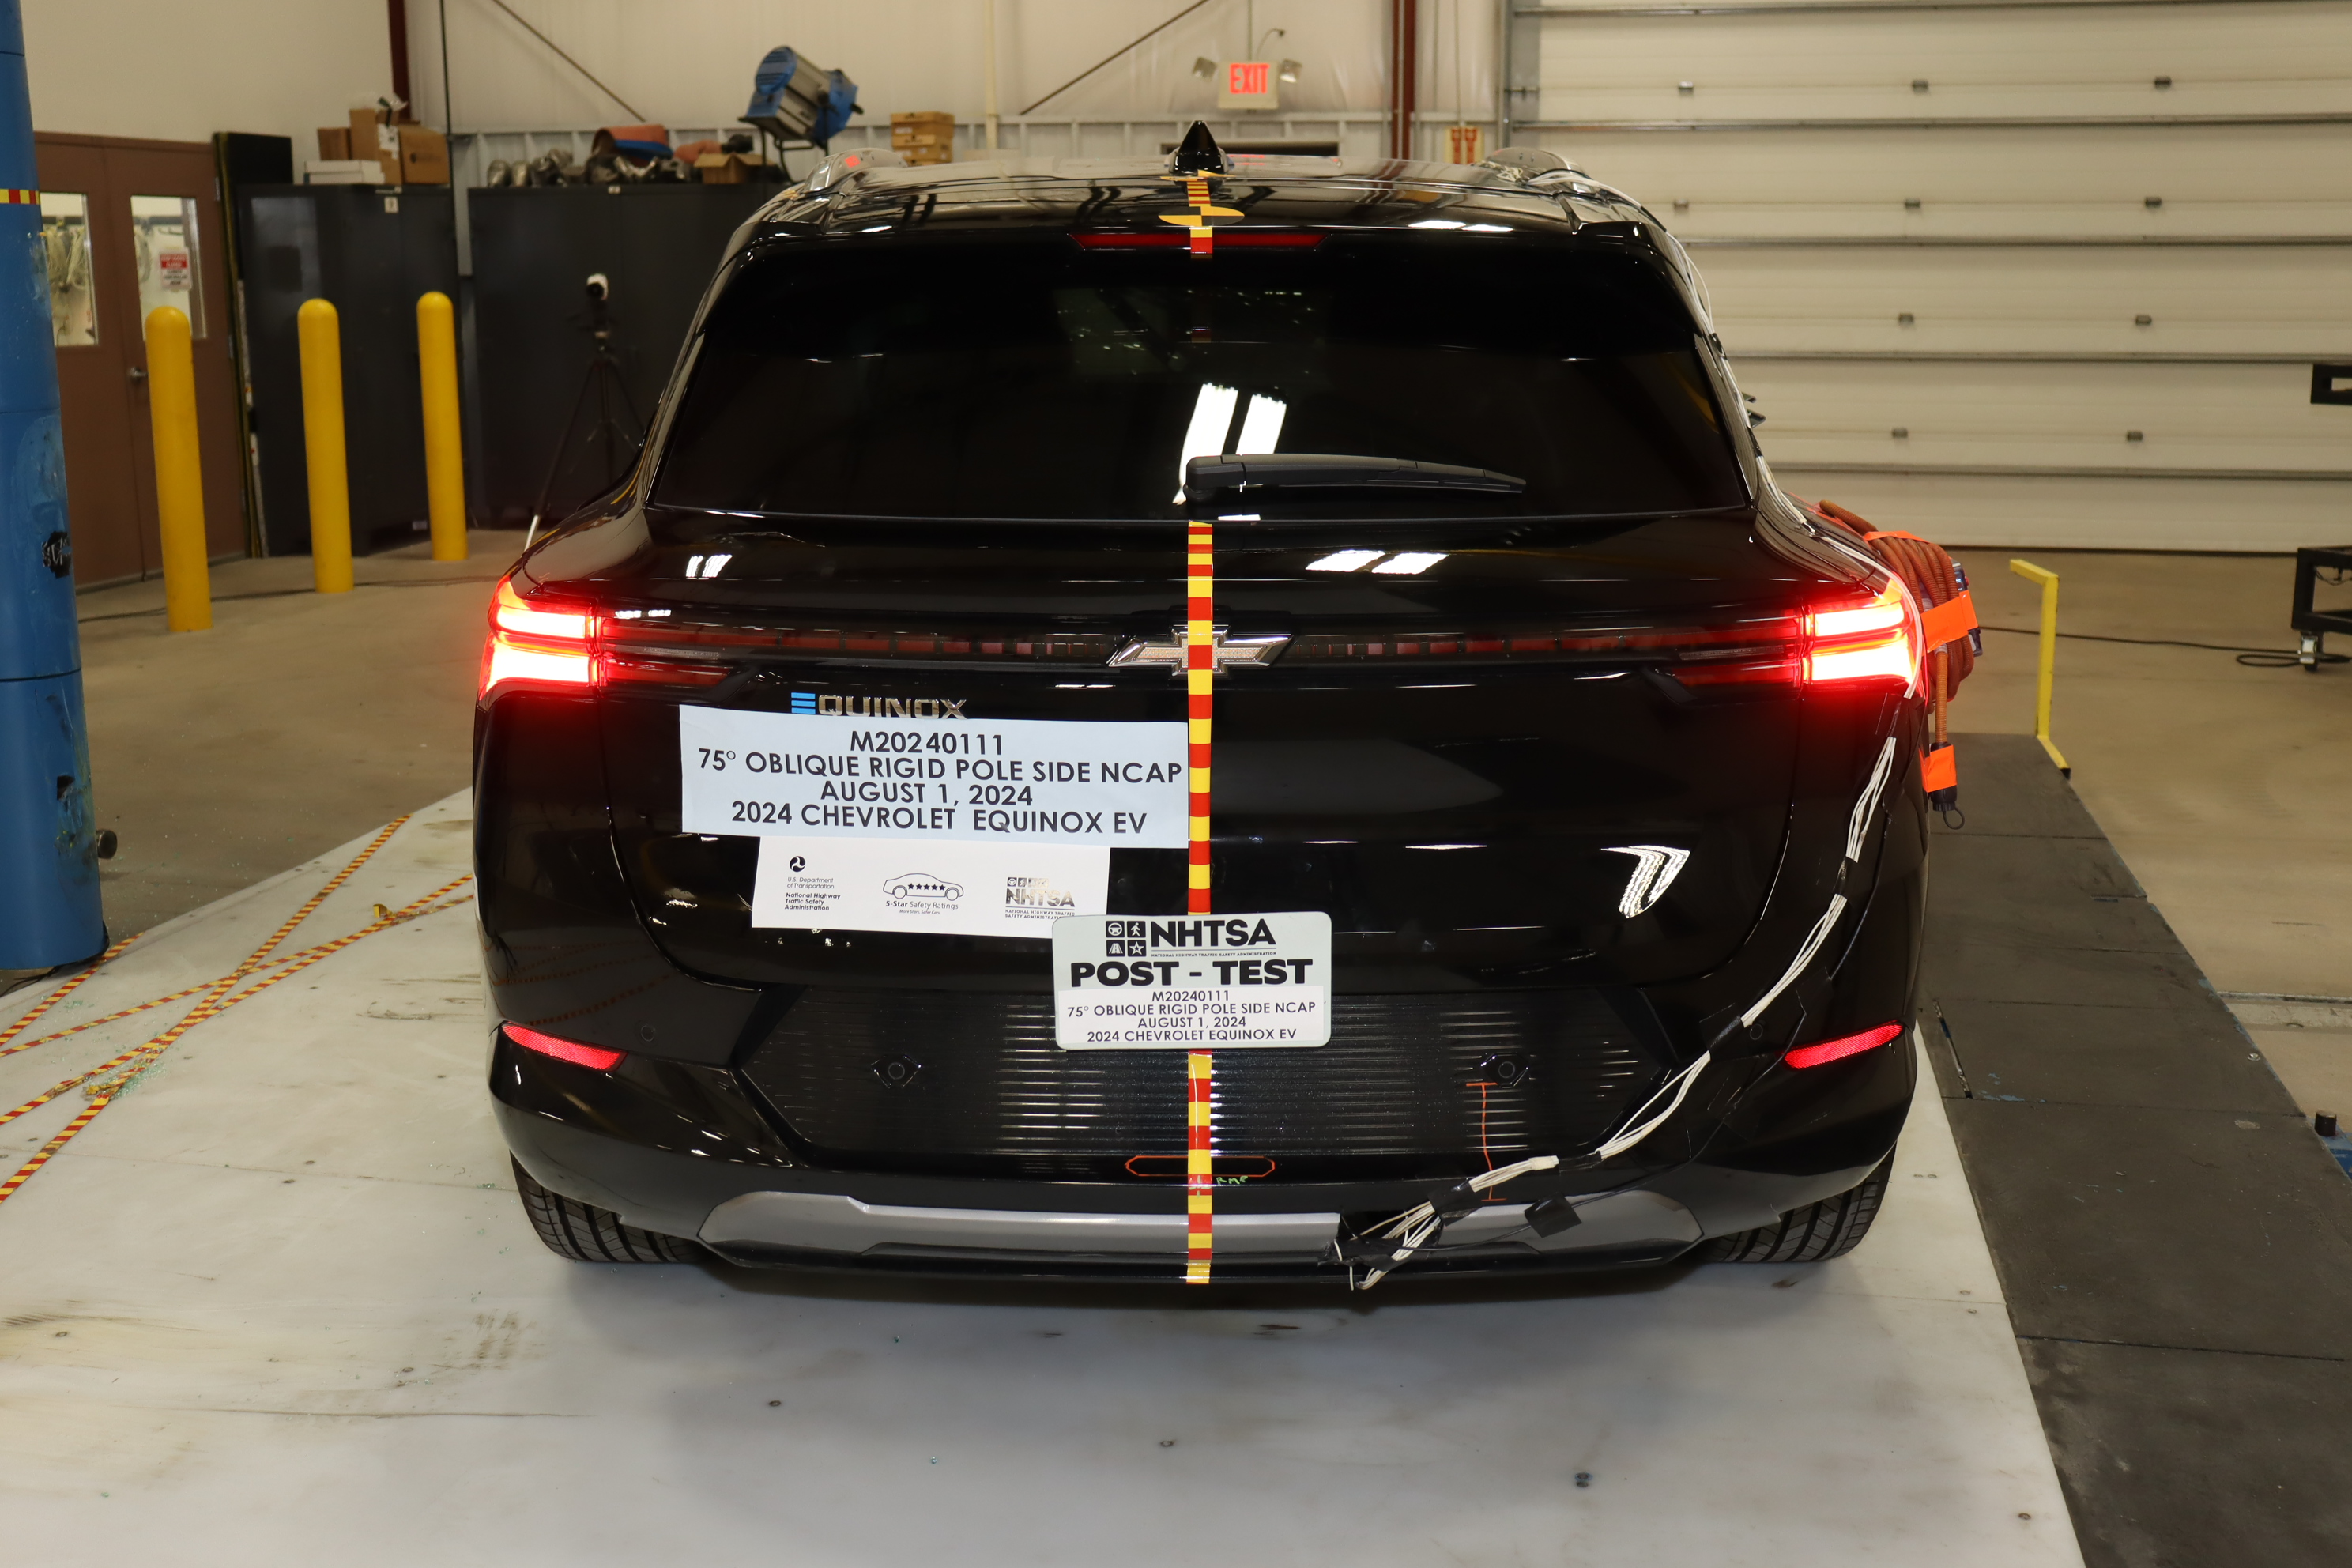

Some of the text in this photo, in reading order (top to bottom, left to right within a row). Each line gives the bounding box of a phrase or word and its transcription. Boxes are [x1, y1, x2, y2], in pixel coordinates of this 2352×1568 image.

[1230, 63, 1270, 94] EXIT
[791, 692, 967, 719] EQUINOX
[850, 731, 1001, 755] M20240111
[699, 748, 1182, 783] 75° OBLIQUE RIGID POLE SIDE NCAP
[820, 781, 1032, 806] AUGUST 1, 2024
[732, 801, 1147, 833] 2024 CHEVROLET EQUINOX EV
[910, 901, 931, 910] Safety
[933, 902, 959, 910] Ratings
[1006, 888, 1075, 907] NHTSA
[1151, 918, 1276, 947] NHTSA
[1071, 961, 1179, 987] POST
[1212, 959, 1313, 985] TEST
[1152, 990, 1228, 1001] M20240111
[1068, 1002, 1315, 1018] 75° OBLIQUE RIGID POLE SIDE NCAP
[1138, 1016, 1246, 1028] AUGUST 1, 2024
[1087, 1029, 1296, 1042] 2024 CHEVROLET EQUINOX EV
